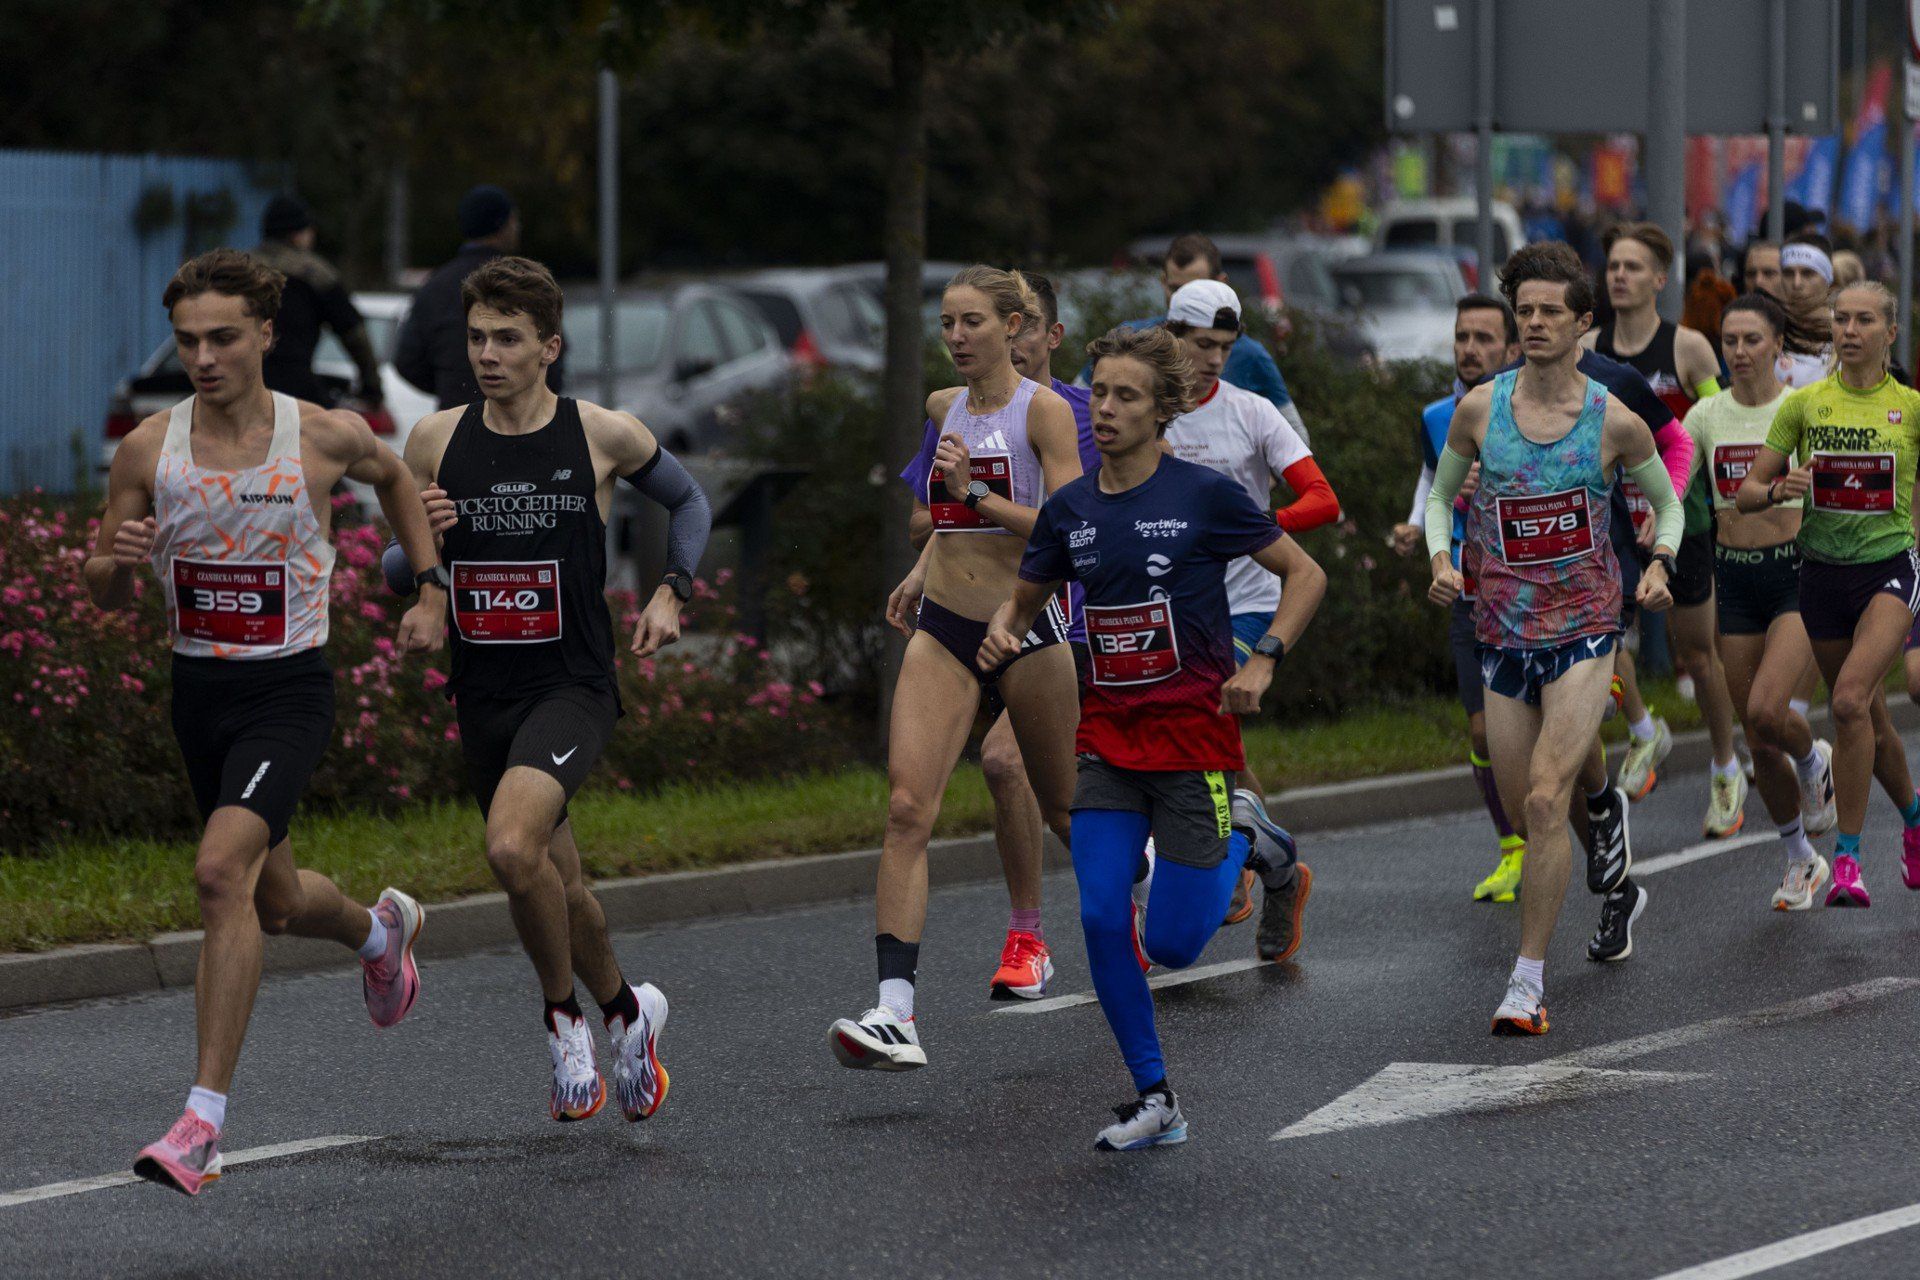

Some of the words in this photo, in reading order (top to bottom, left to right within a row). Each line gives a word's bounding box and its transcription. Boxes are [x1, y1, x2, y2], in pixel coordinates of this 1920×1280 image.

[1807, 426, 1877, 440] DREWNO
[1808, 439, 1870, 451] FORNIR
[1722, 461, 1753, 479] 15
[497, 484, 530, 493] GLUE
[1844, 473, 1862, 489] 4
[240, 493, 294, 505] KIPRUN
[454, 494, 587, 515] TICK-TOGETHER
[472, 512, 557, 532] RUNNING
[1134, 518, 1188, 531] SportWise
[1511, 512, 1578, 538] 1578
[1725, 548, 1764, 564] PRO
[193, 589, 262, 614] 359
[469, 590, 539, 610] 1140
[1096, 630, 1156, 653] 1327
